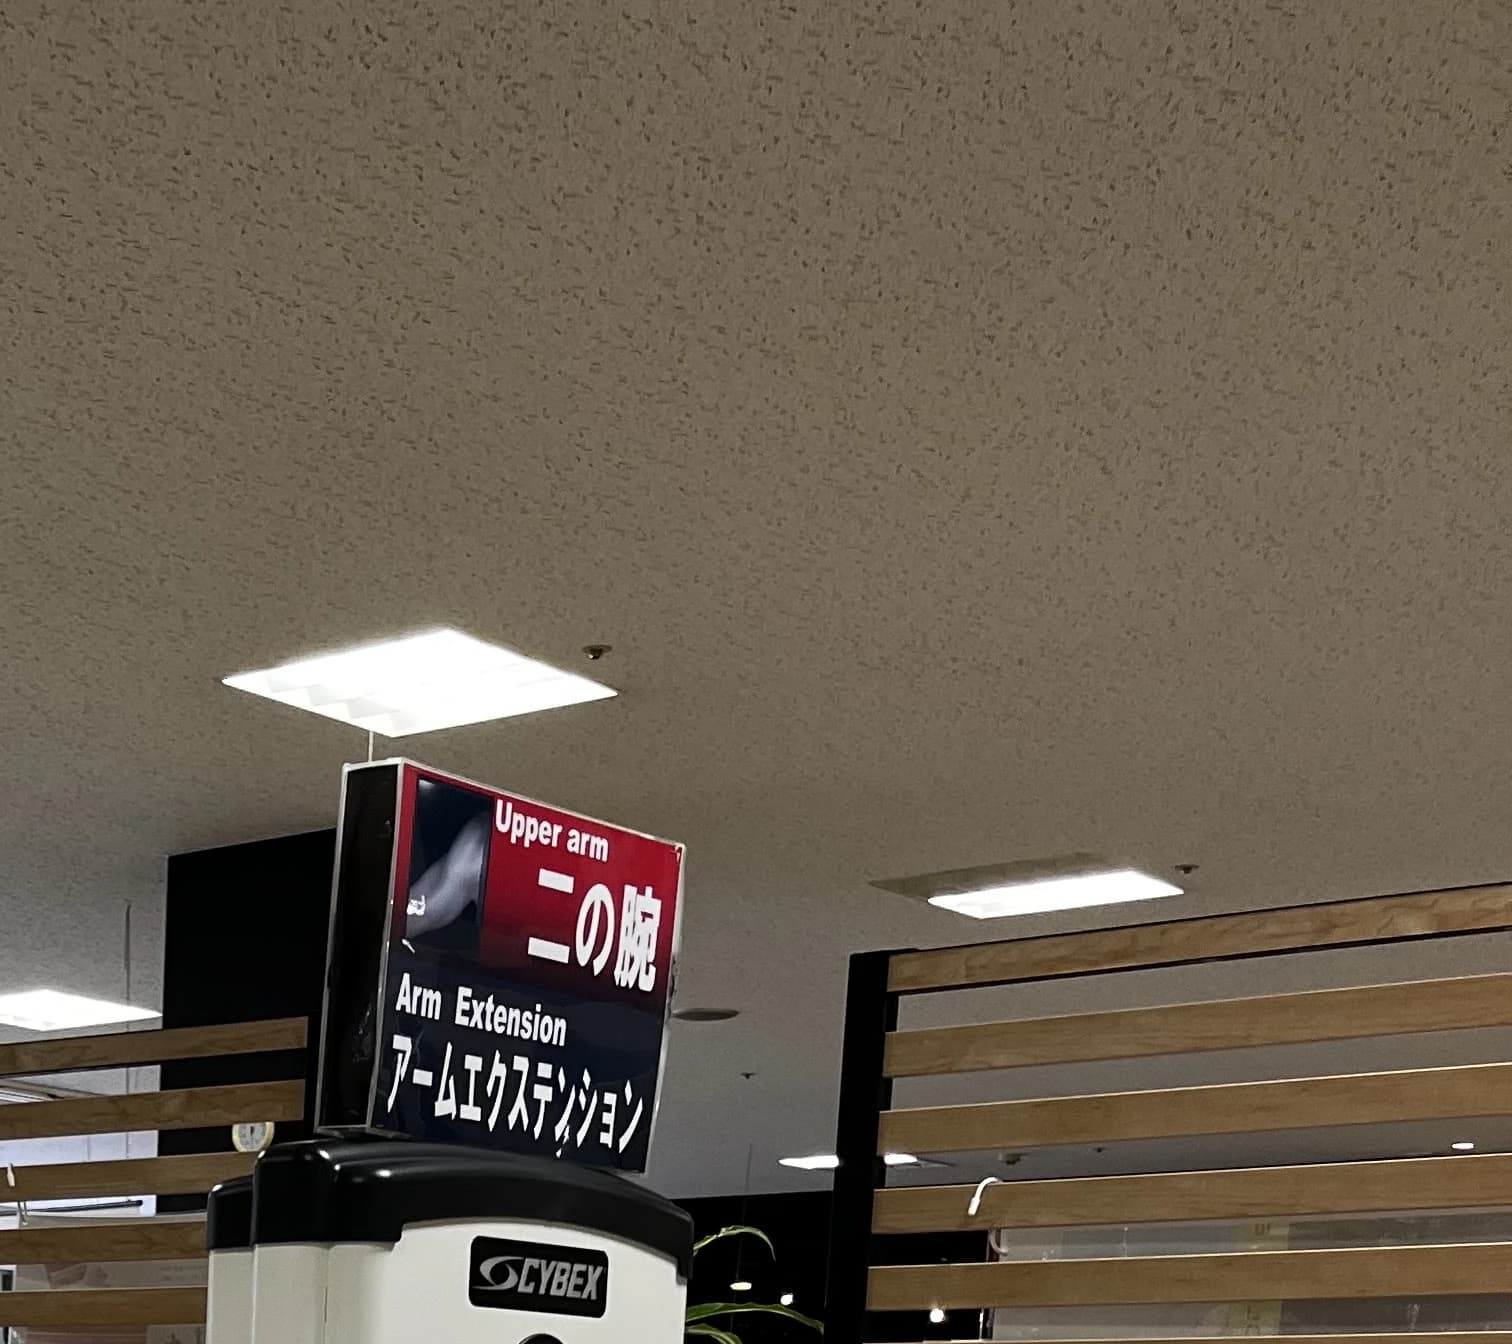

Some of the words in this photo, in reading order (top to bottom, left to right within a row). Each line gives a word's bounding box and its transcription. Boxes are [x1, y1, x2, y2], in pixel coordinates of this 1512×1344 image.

[496, 799, 562, 847] Upper
[567, 828, 609, 862] arm
[528, 868, 662, 992] 二の腕
[395, 972, 441, 1019] Arm
[454, 986, 567, 1047] Extension
[387, 1034, 643, 1154] アームエクステンション
[517, 1257, 604, 1300] CYBEX
